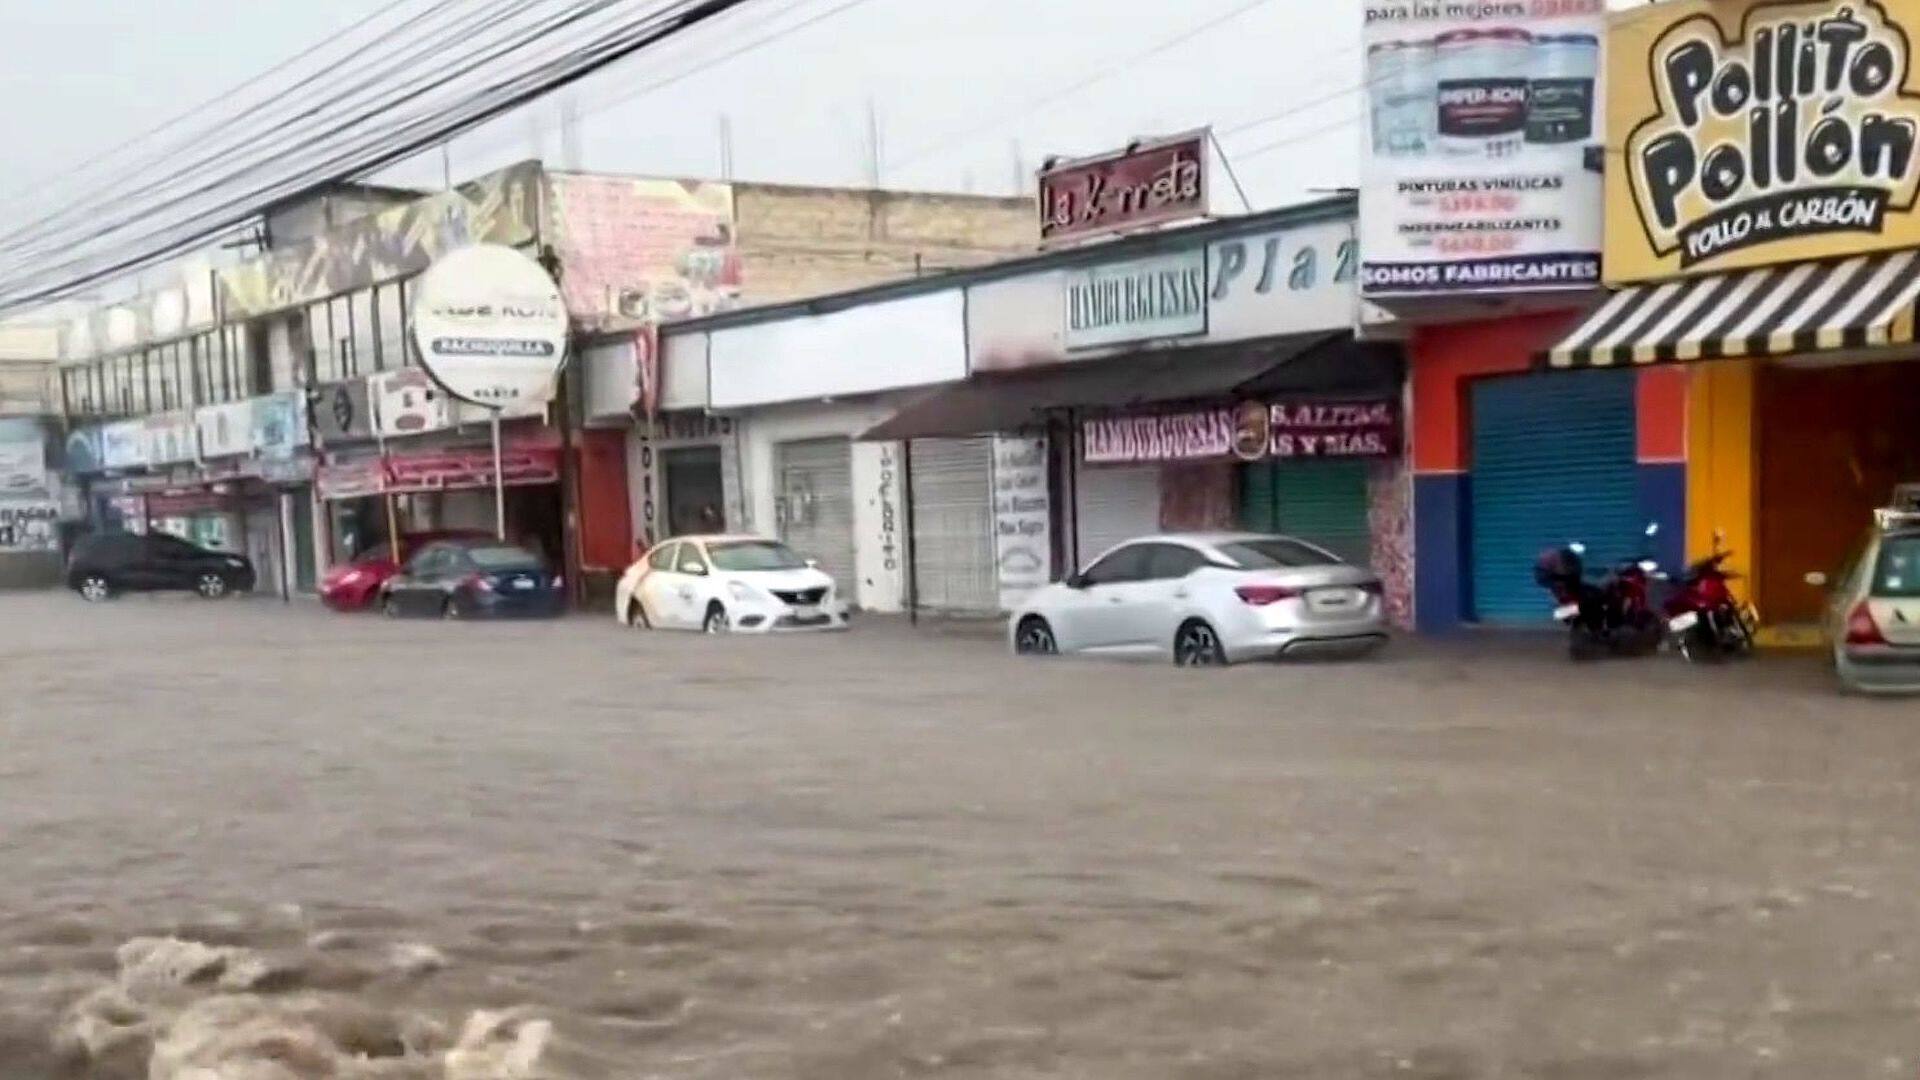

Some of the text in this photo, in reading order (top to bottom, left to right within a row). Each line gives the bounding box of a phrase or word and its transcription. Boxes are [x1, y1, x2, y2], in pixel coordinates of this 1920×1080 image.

[1366, 6, 1407, 21] para
[1413, 3, 1439, 17] las
[1447, 1, 1524, 19] mejores
[1643, 97, 1917, 229] Pollón
[1398, 178, 1477, 192] PINTURAS
[1043, 186, 1070, 228] La
[1398, 219, 1561, 234] IMPERMEABILIZANTES
[1687, 191, 1877, 257] POLLO AL CARBÓN
[1362, 261, 1598, 284] SOMOS FABRICANTES
[1084, 409, 1232, 461] HAMBURGUESAS
